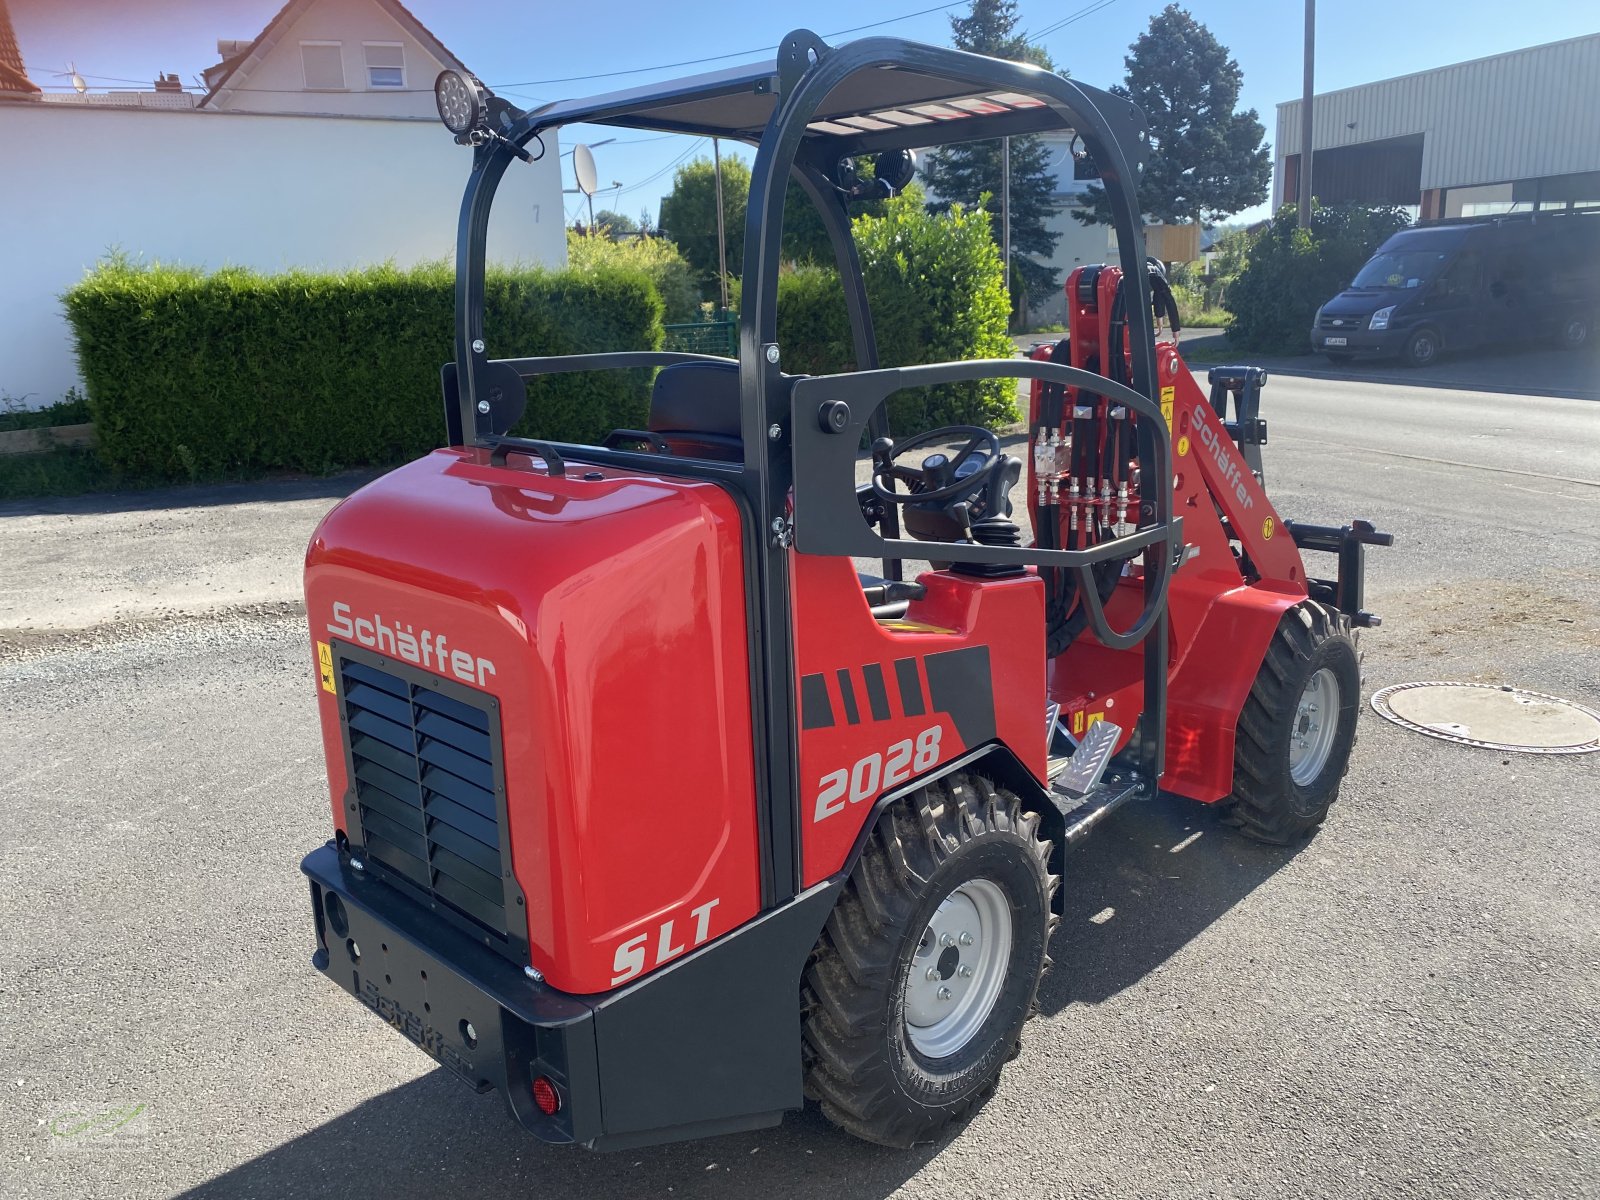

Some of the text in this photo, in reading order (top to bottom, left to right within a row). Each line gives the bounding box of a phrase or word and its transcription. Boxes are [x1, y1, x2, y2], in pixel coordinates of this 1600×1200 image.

[532, 204, 540, 223] 7
[1191, 404, 1254, 510] Schäffer
[326, 601, 496, 686] Schäffer
[813, 725, 942, 824] 2028
